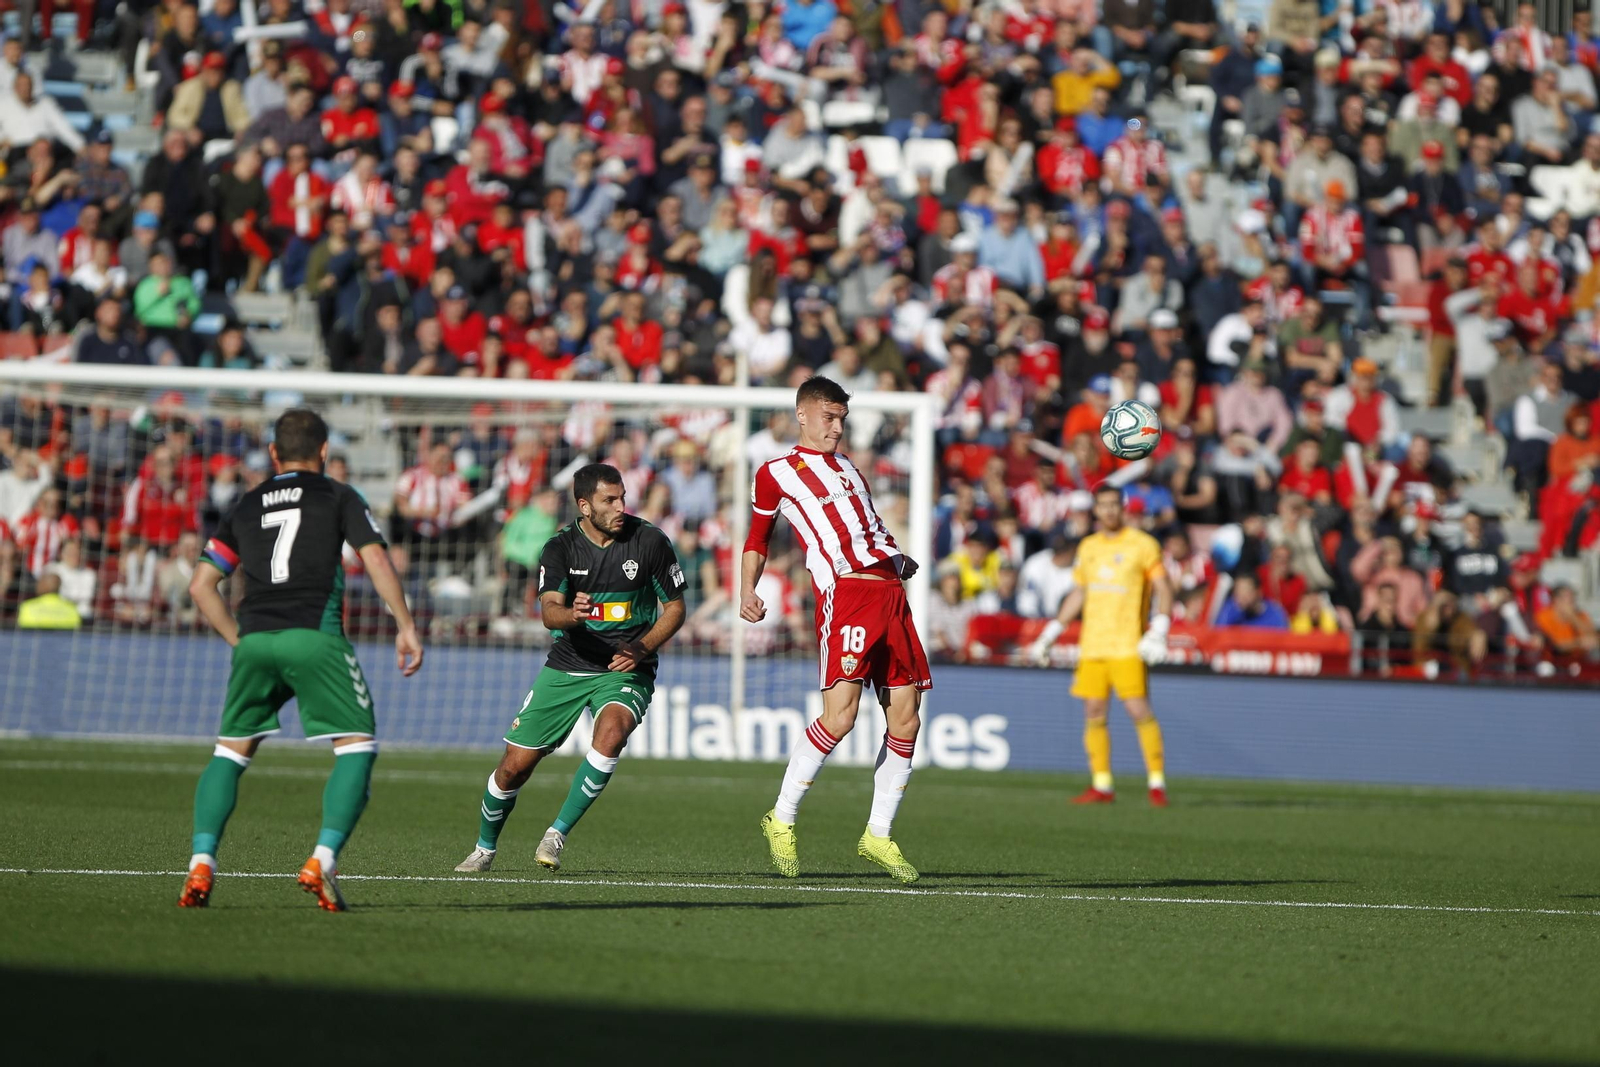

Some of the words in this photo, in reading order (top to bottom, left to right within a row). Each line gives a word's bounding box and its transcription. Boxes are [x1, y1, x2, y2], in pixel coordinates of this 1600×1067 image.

[262, 487, 303, 507] NINO
[819, 490, 853, 505] Arabian
[261, 508, 301, 584] 7
[840, 625, 866, 653] 18
[519, 690, 534, 714] 9
